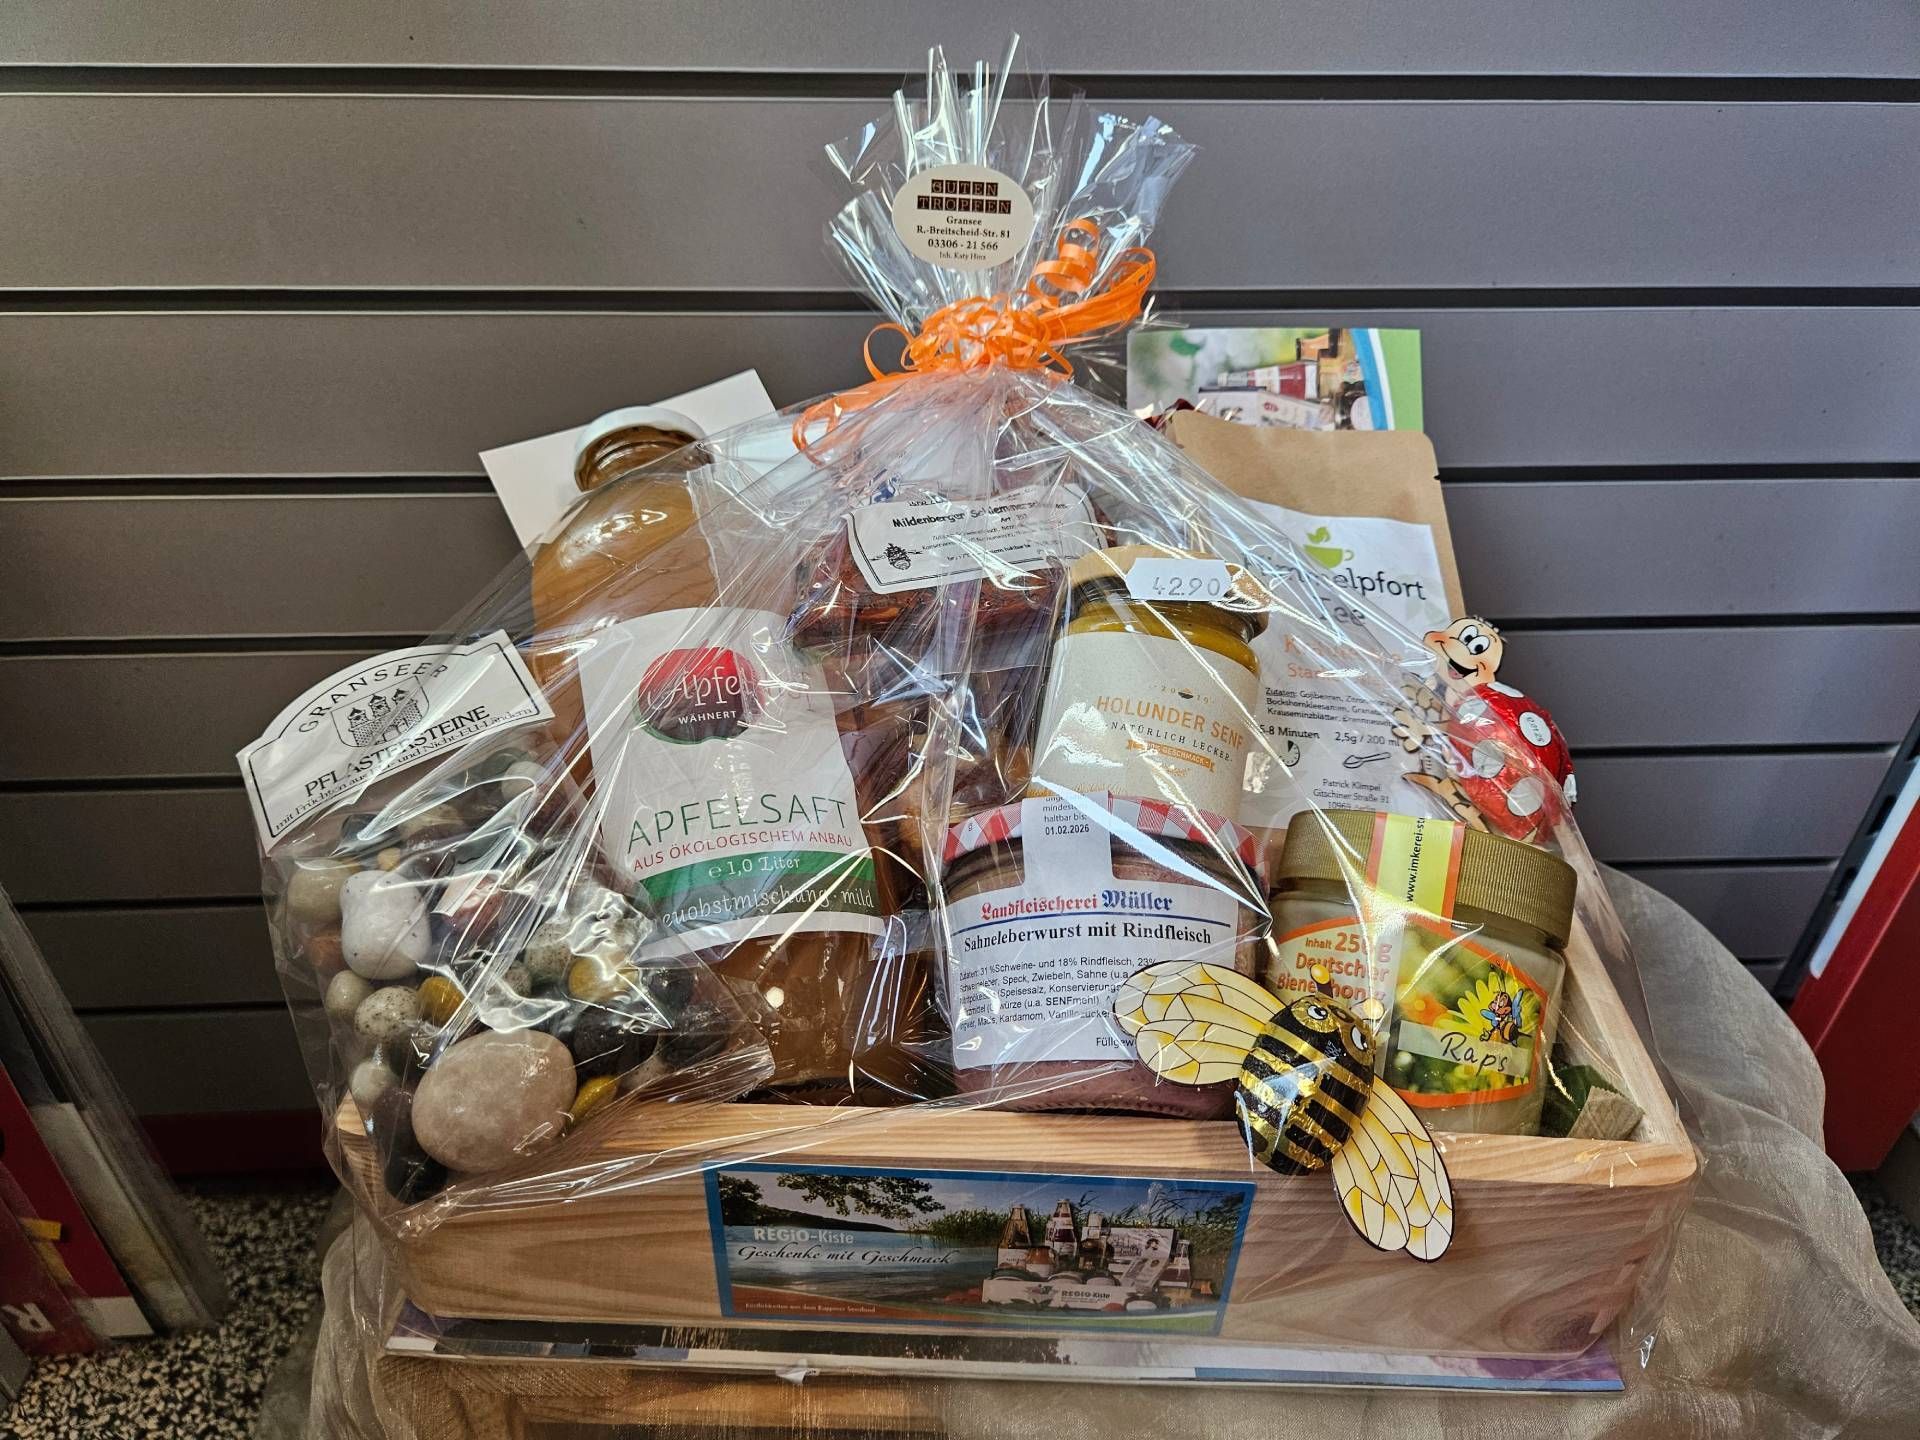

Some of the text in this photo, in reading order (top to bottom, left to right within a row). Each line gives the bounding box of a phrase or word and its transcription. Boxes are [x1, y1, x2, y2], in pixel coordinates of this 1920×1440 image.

[931, 179, 998, 197] GUTEN
[917, 196, 1011, 214] TROPFEN
[946, 216, 982, 225] Gransee
[1000, 230, 1011, 239] 81
[928, 239, 958, 249] 03306
[966, 241, 977, 250] 21
[980, 242, 998, 251] 566
[892, 512, 966, 528] Mildenberger
[298, 662, 448, 733] GRANSEER
[678, 710, 737, 725] WÄHNERT
[1096, 695, 1245, 750] HOLUNDER SENF
[1111, 721, 1186, 744] NATÜRLICH
[1278, 726, 1320, 739] Minuten
[627, 793, 847, 853] APFELSAFT
[1044, 814, 1072, 823] haltbar
[1045, 823, 1090, 836] 01.02.2026
[633, 829, 853, 872] AUS ÖKOLOGISCHEM ANBAU
[728, 858, 752, 877] 1,0
[758, 855, 801, 871] Liter
[840, 888, 874, 908] mild
[981, 889, 1173, 921] Landfleischerei Müller
[964, 922, 1211, 953] Sahneleberwurst mit Rindfleisch
[1305, 937, 1333, 949] Inhalt
[1038, 959, 1055, 969] und
[1058, 957, 1078, 967] 18%
[1080, 956, 1135, 967] Rindfleisch,
[1002, 973, 1030, 985] Speck,
[1031, 971, 1074, 982] Zwiebeln,
[1076, 969, 1108, 979] Sahne
[999, 1011, 1046, 1023] Kardamom,
[1440, 1031, 1508, 1076] Raps
[738, 1241, 960, 1265] Geschenke mit Geschmack
